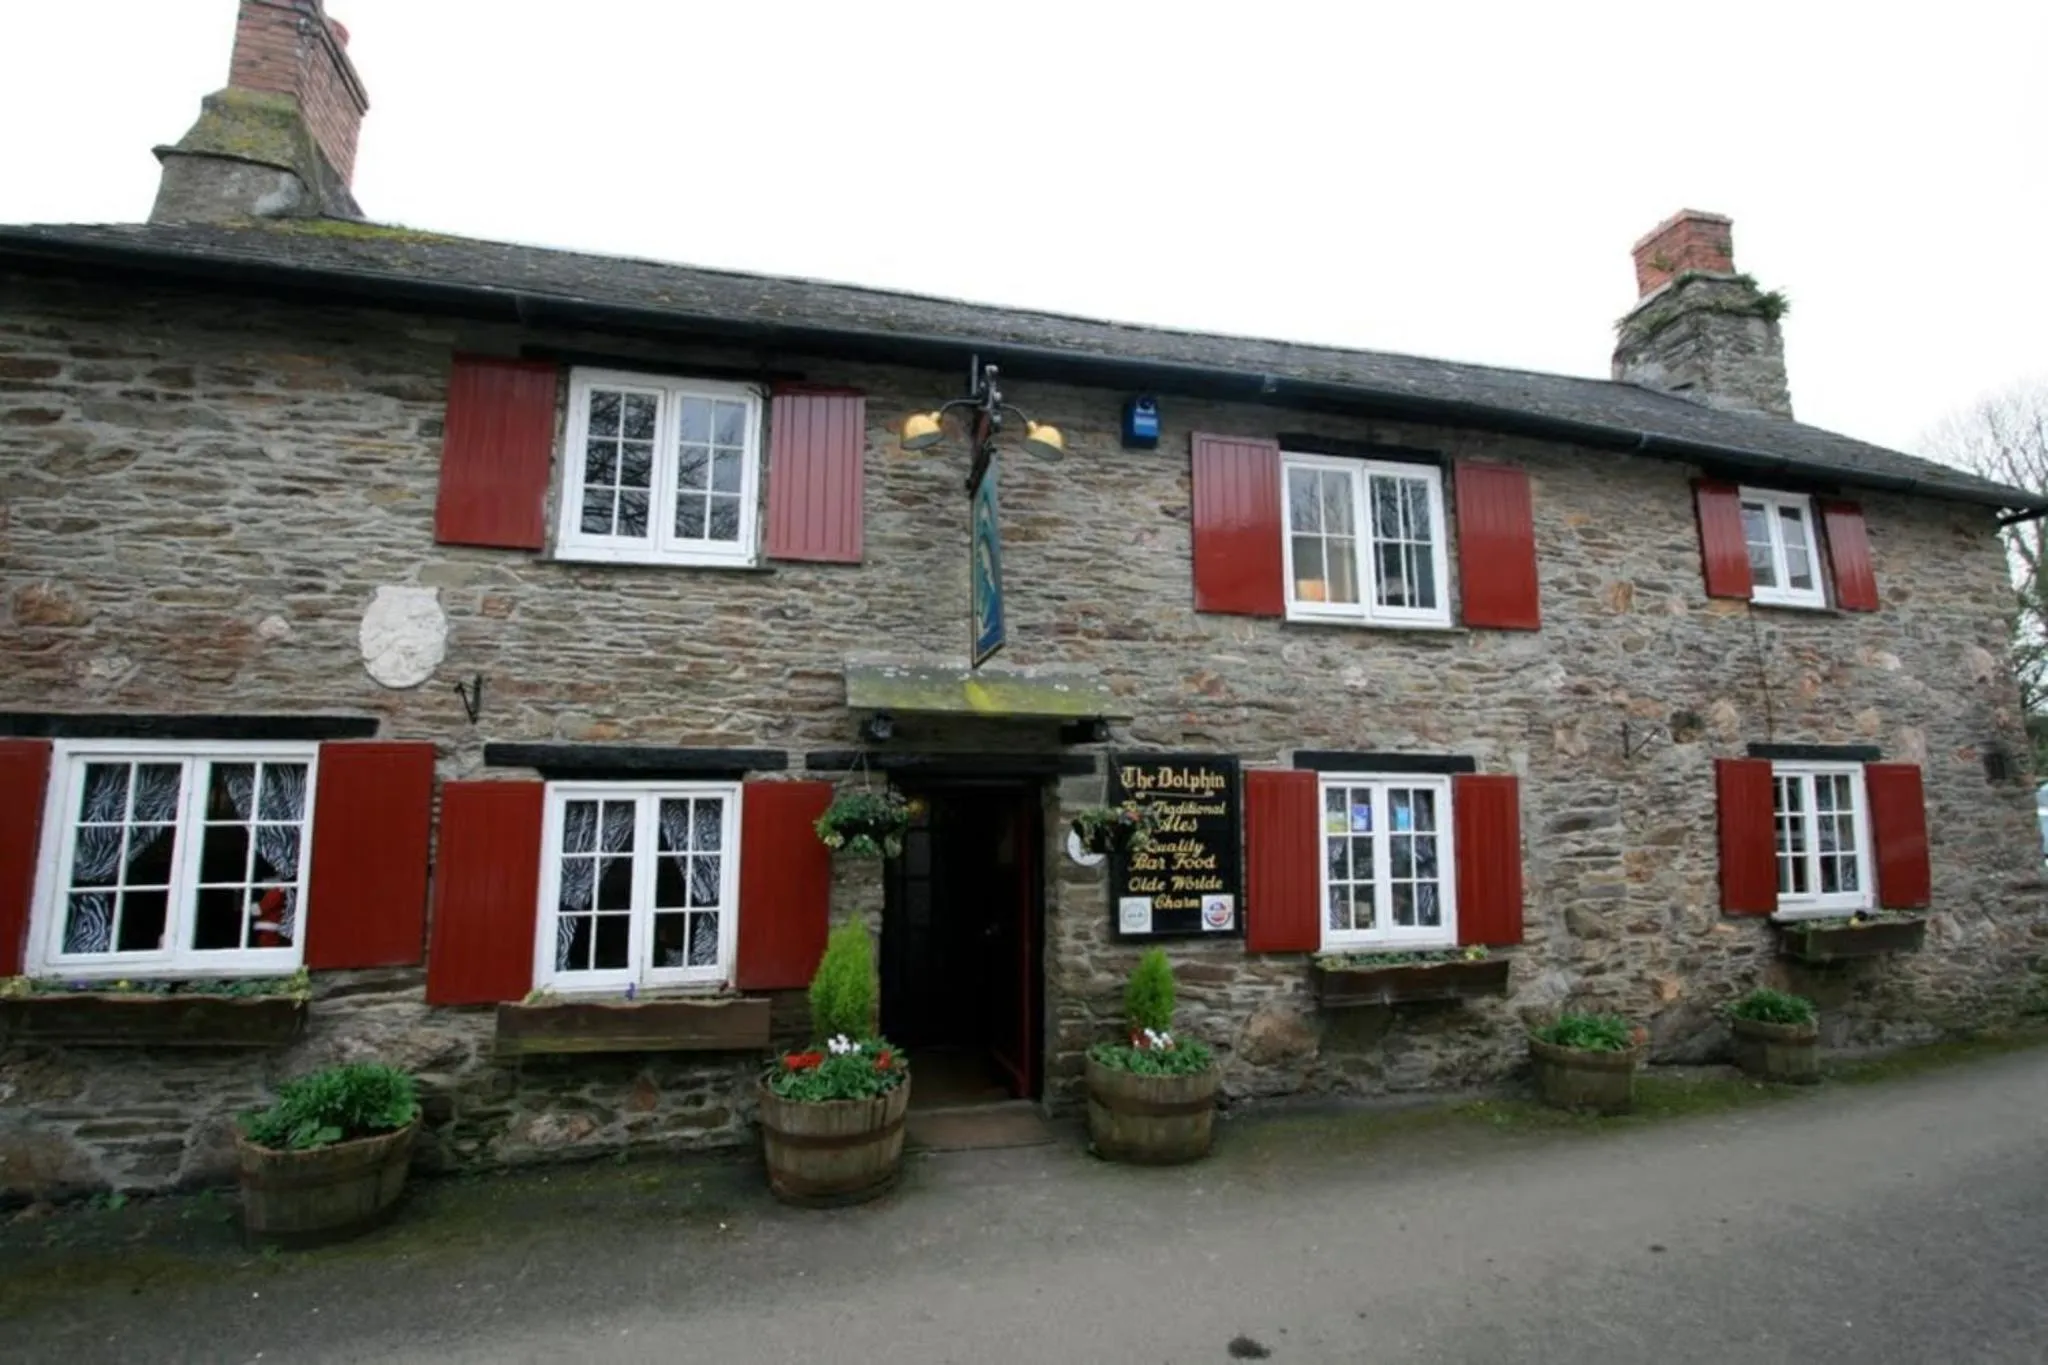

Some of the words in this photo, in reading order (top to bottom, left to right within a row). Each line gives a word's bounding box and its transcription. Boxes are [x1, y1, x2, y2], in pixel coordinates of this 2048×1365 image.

[1121, 766, 1155, 789] The
[1157, 766, 1226, 792] Dolphin
[1145, 838, 1204, 858] Quality
[1128, 852, 1166, 871] Bar
[1171, 853, 1216, 870] Food
[1128, 876, 1166, 892] Olde
